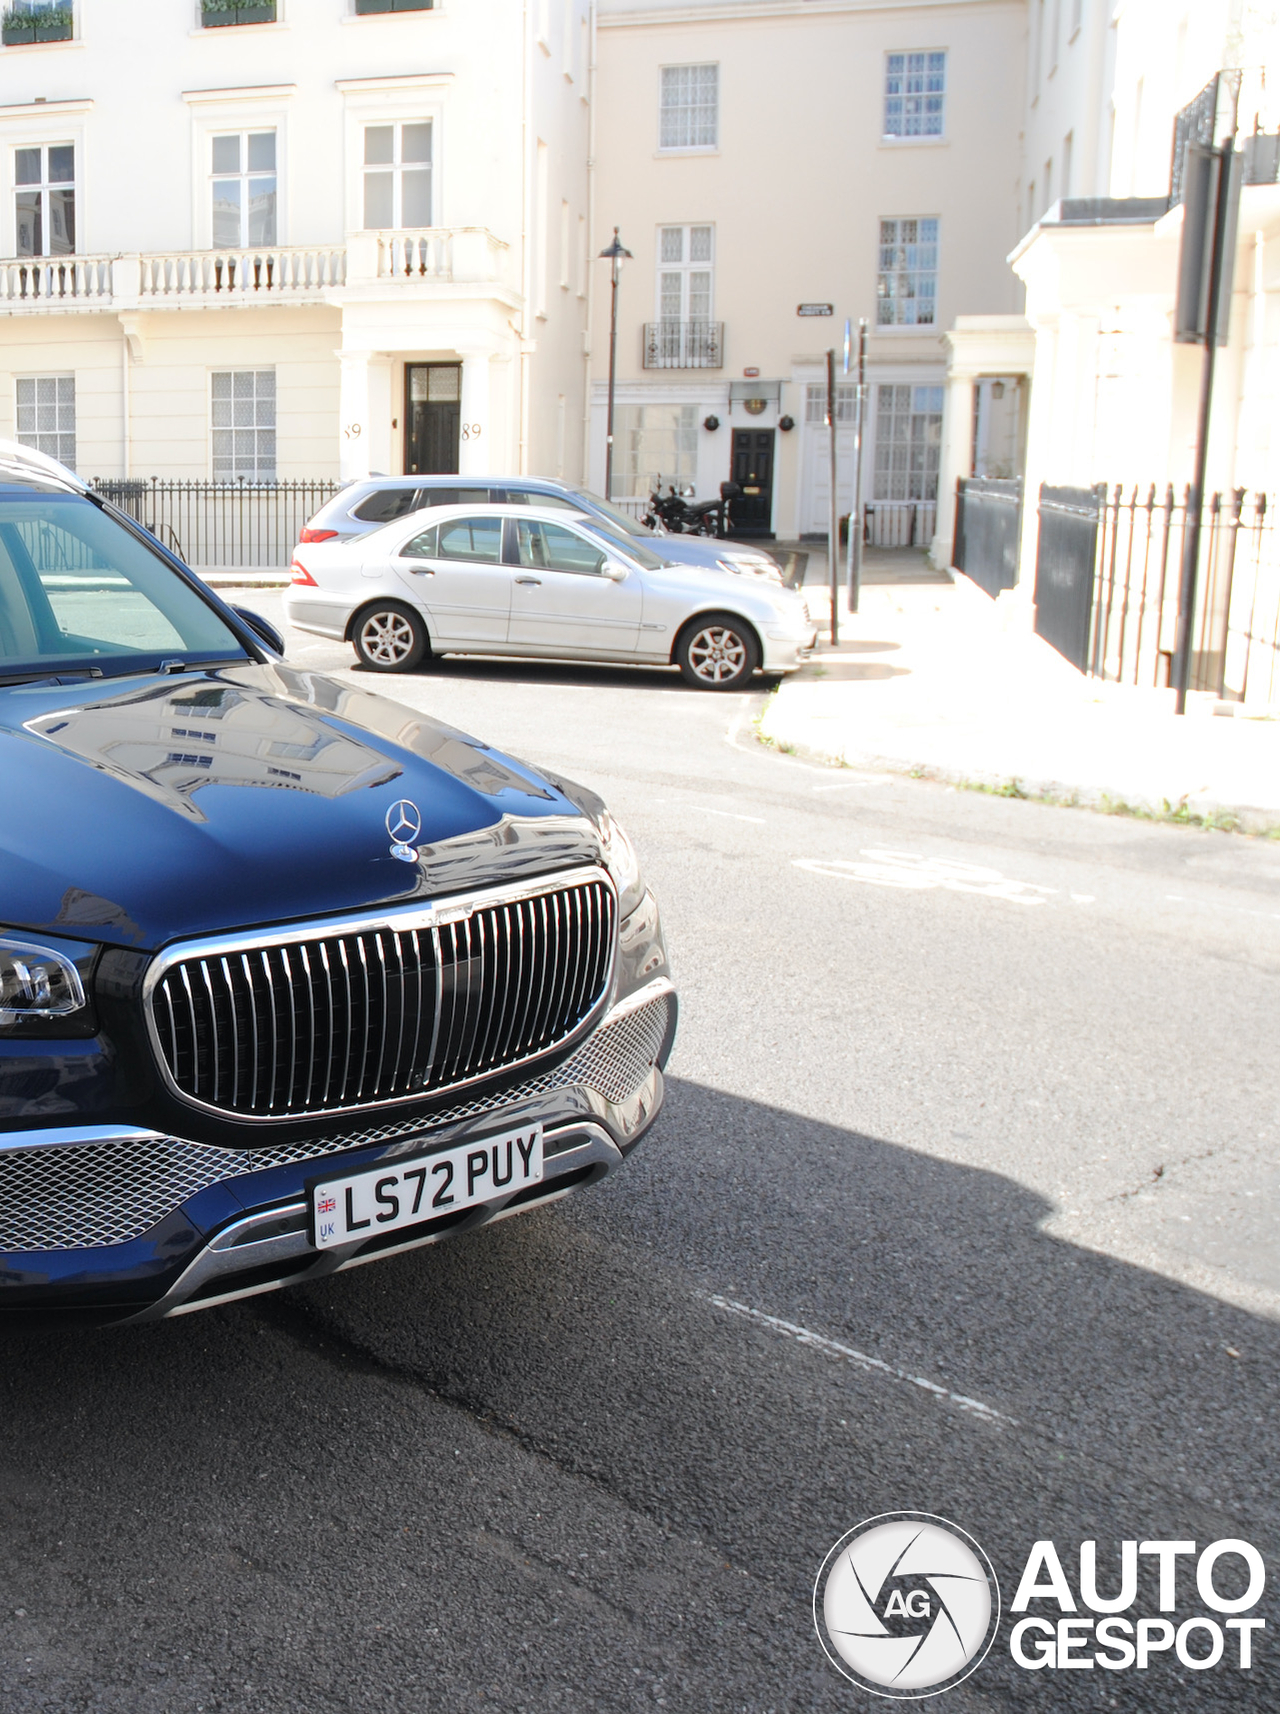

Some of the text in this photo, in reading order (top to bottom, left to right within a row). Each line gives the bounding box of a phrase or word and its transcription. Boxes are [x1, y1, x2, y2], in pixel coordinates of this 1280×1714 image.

[461, 423, 482, 441] 89
[345, 1133, 537, 1232] LS72 PUY
[320, 1222, 335, 1237] UK
